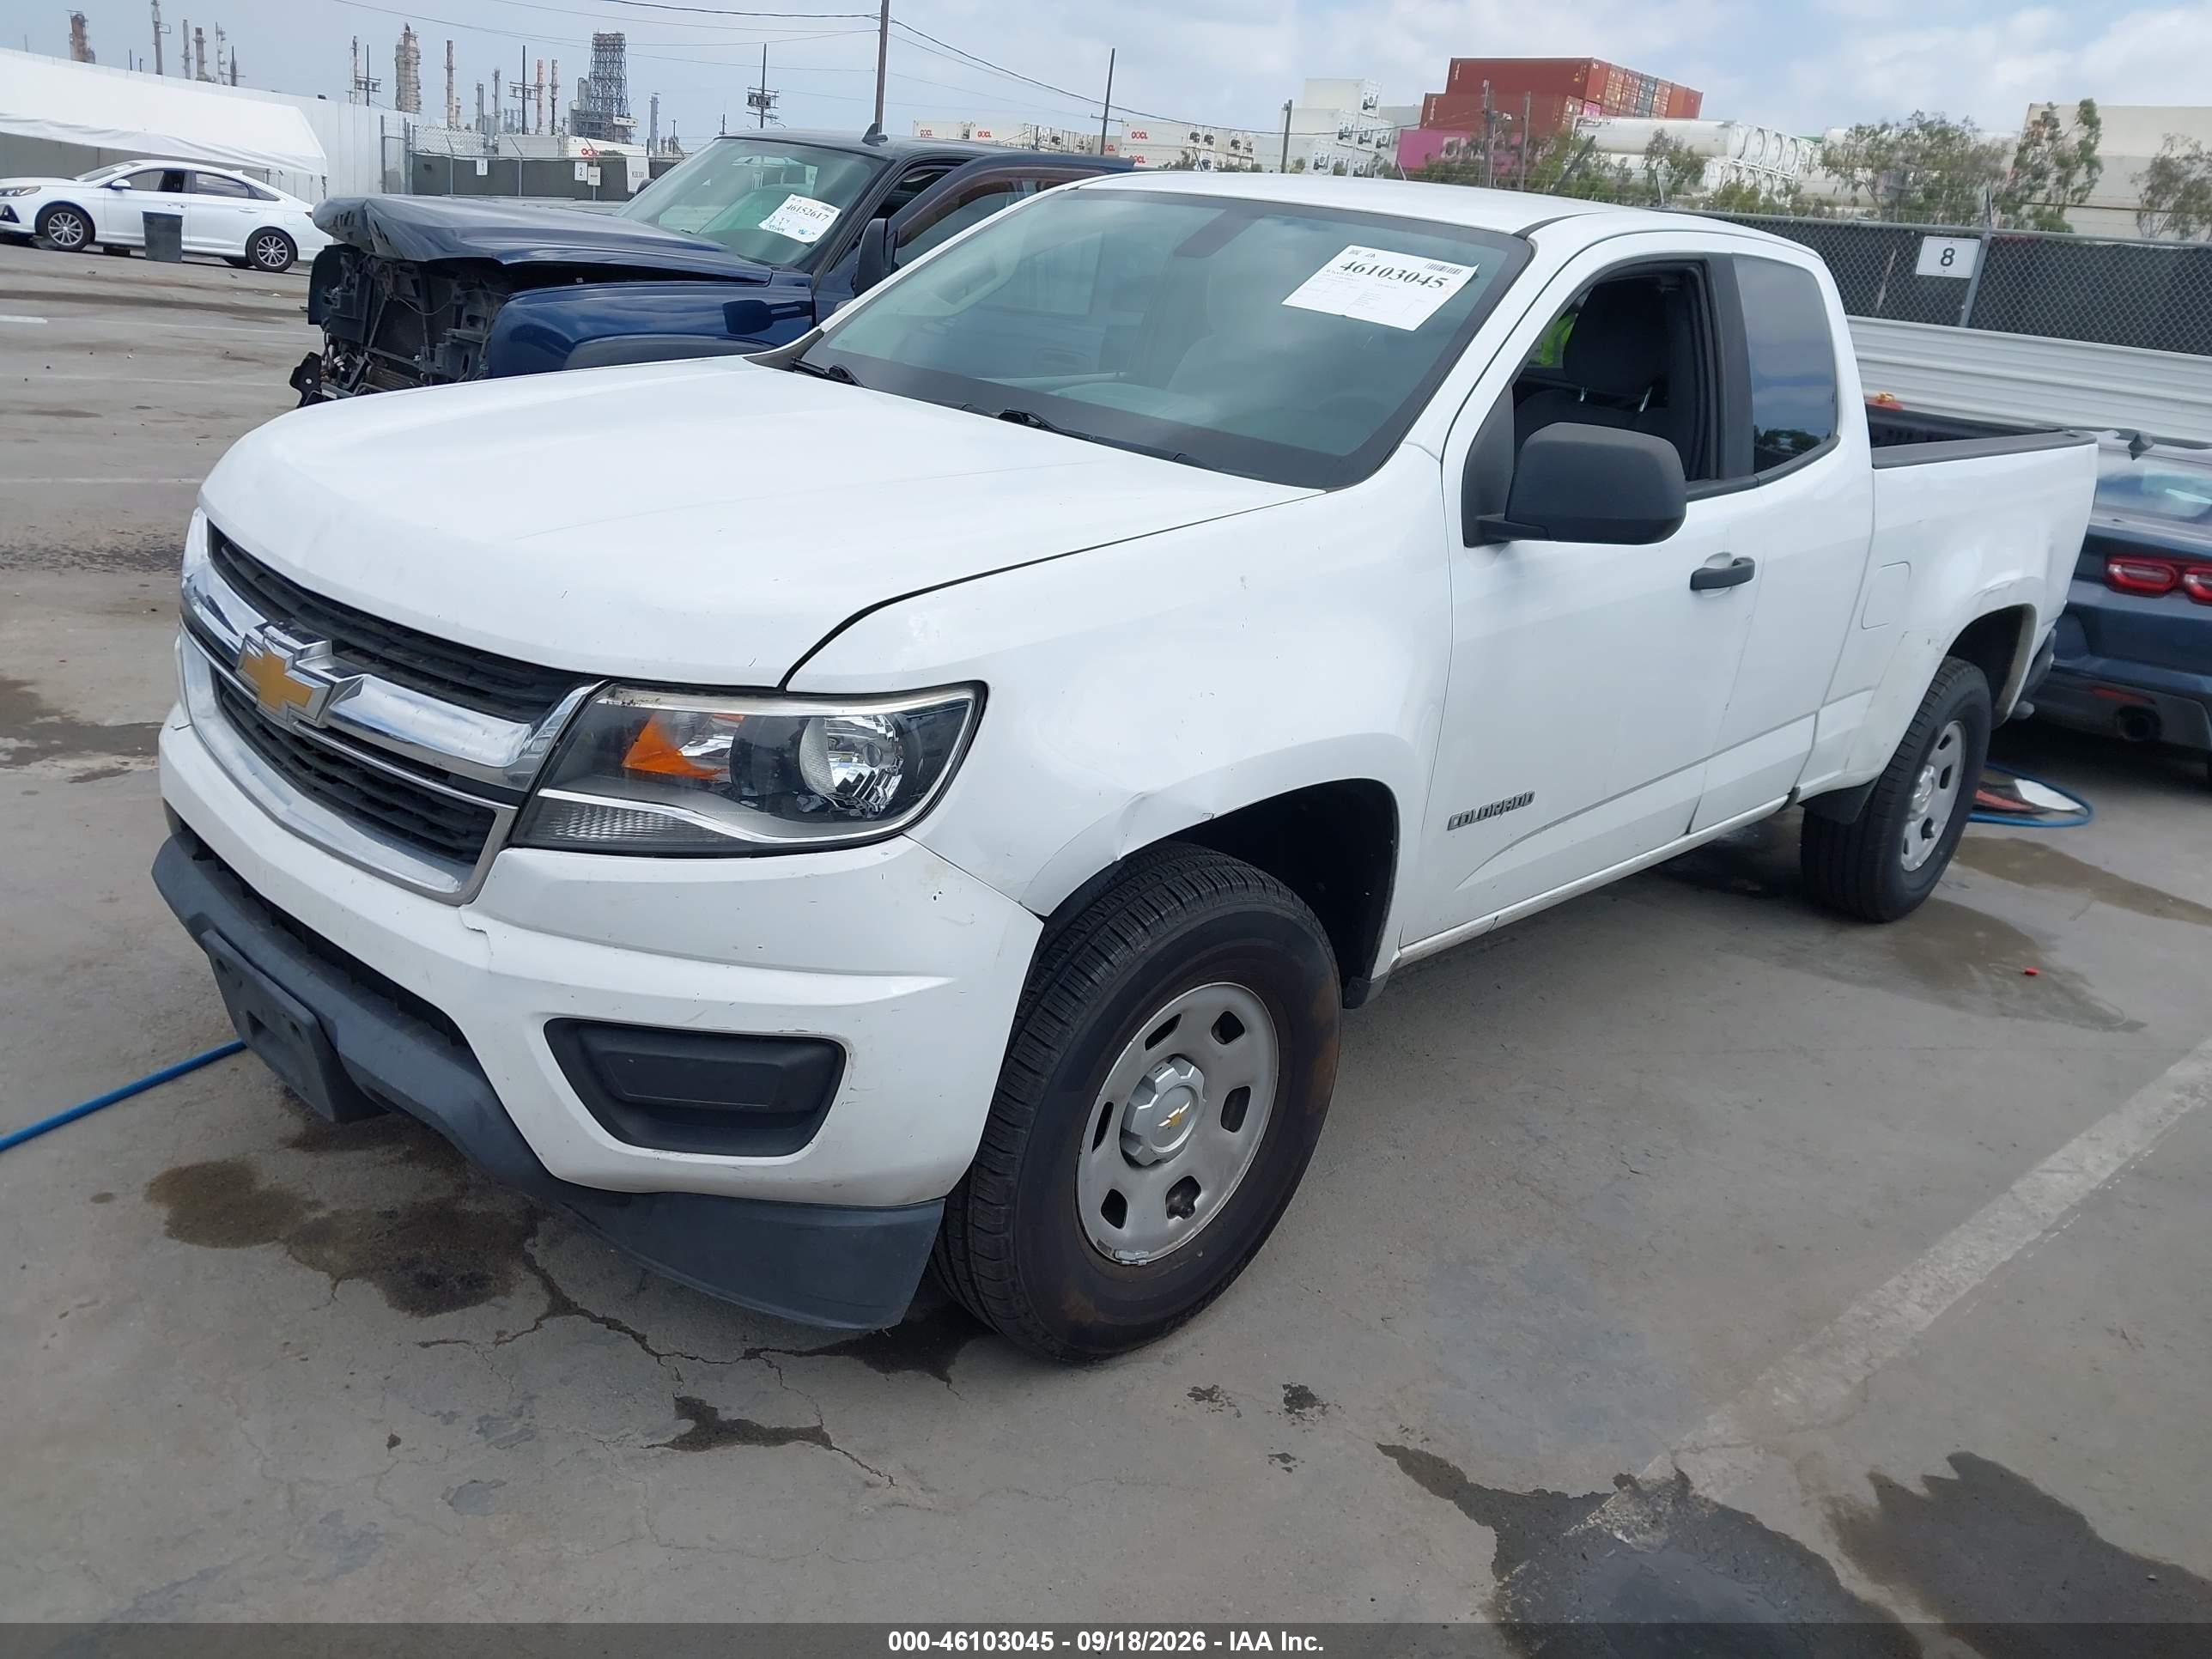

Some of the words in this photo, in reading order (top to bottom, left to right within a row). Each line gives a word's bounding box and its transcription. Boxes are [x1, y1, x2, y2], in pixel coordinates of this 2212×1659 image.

[786, 204, 830, 222] 46152617
[1941, 247, 1955, 266] 8
[1340, 260, 1449, 289] 46103045
[1447, 790, 1535, 831] COLORADO
